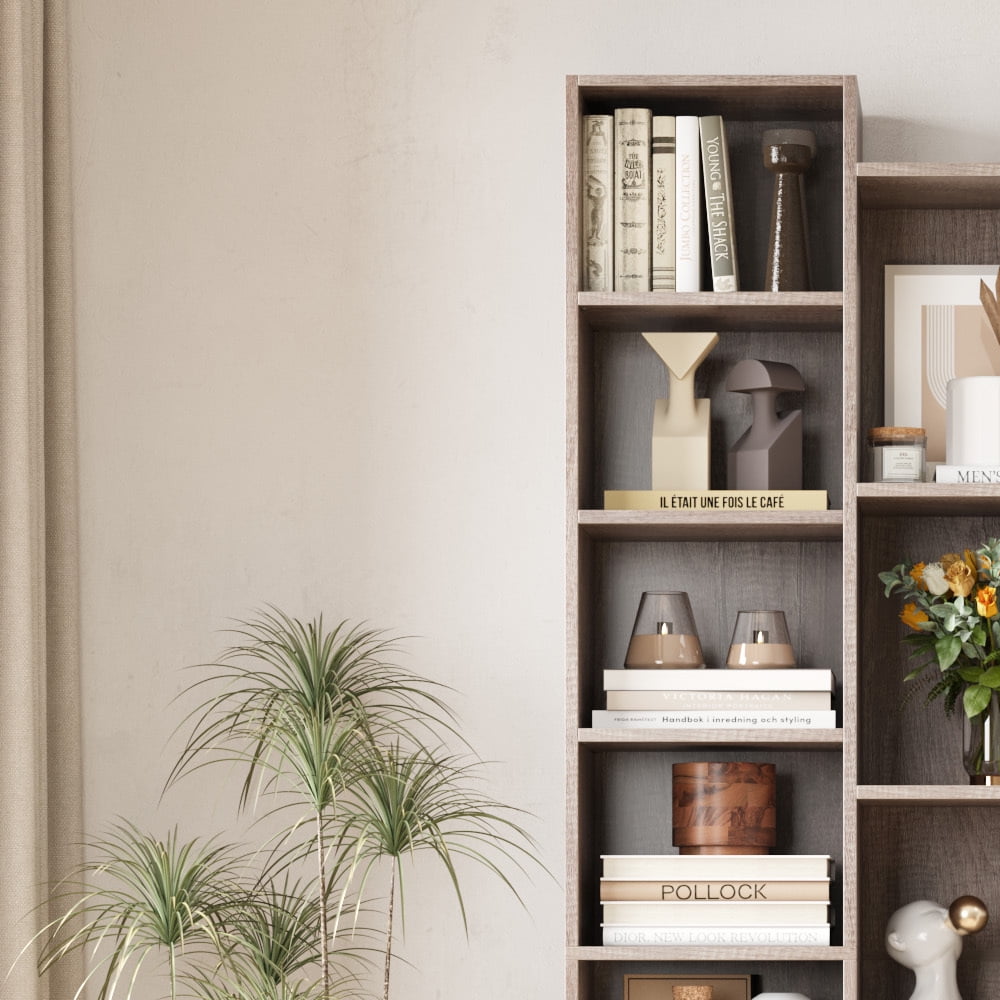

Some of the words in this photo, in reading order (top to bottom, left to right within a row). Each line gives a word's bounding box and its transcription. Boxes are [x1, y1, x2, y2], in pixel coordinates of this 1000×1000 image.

[706, 136, 722, 182] YOUNG
[679, 154, 691, 222] COLLECTION
[710, 193, 725, 217] THE
[711, 221, 729, 261] SHACK
[660, 497, 669, 508] IL
[671, 494, 698, 508] ÉTAIT
[700, 497, 720, 508] UNE
[722, 497, 743, 508] FOIS
[746, 497, 758, 508] LE
[760, 494, 785, 508] CAFÉ
[663, 693, 735, 701] VICTORIA
[740, 693, 793, 701] HAGAN
[662, 715, 704, 724] Handbok
[712, 715, 758, 725] inredning
[761, 715, 778, 724] och
[781, 715, 812, 725] styling
[661, 884, 768, 900] POLLOCK
[654, 932, 684, 943] NEW
[689, 932, 727, 943] LOOK
[730, 932, 818, 943] REVOLUTION
